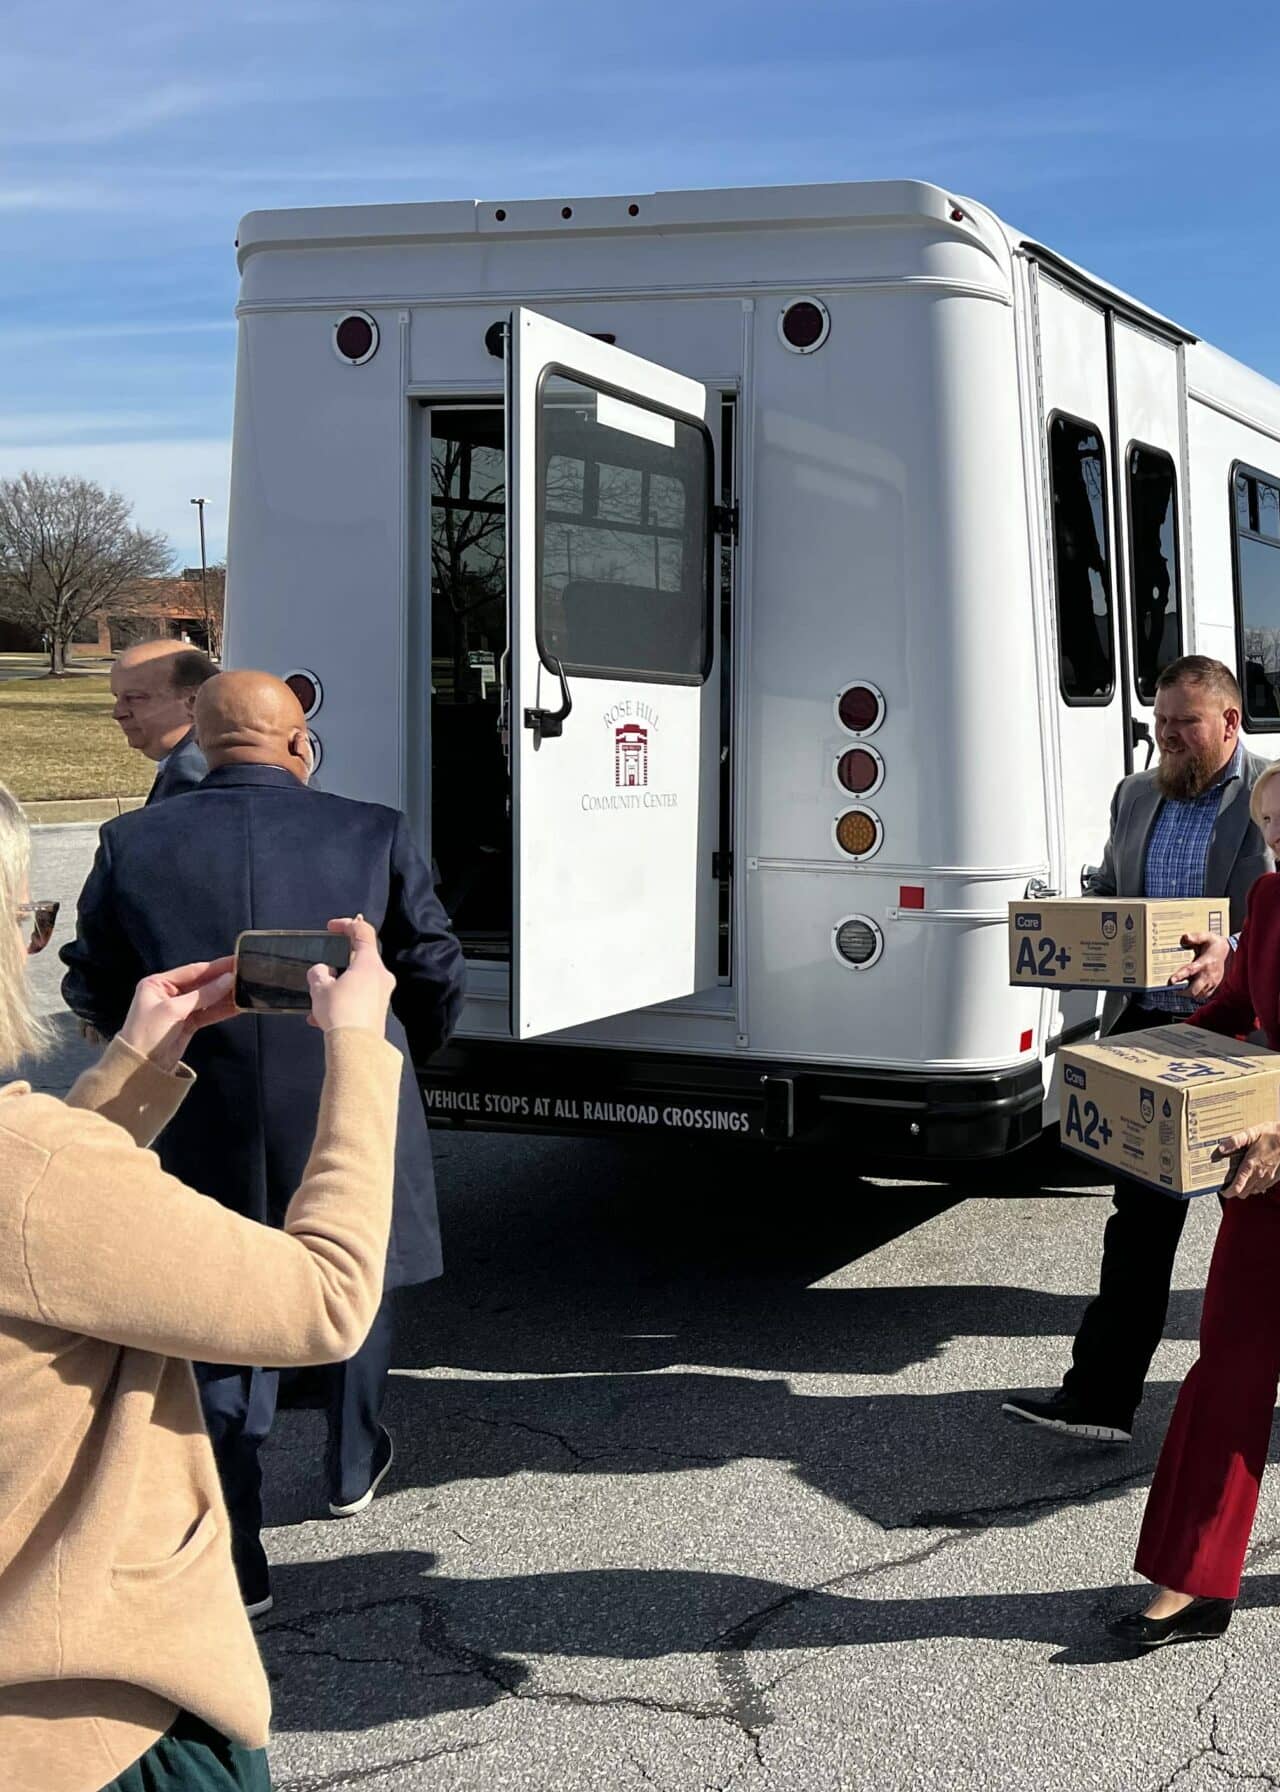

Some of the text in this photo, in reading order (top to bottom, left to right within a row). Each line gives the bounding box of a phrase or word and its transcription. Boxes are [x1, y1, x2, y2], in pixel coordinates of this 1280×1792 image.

[603, 700, 660, 732] ROSE HILL
[581, 791, 679, 811] COMMUNITY CENTER
[1016, 915, 1040, 929] Care
[1015, 937, 1072, 976] A2+
[424, 1089, 750, 1132] VEHICLE STOPS AT ALL RAILROAD CROSSINGS
[1065, 1093, 1113, 1149] A2+
